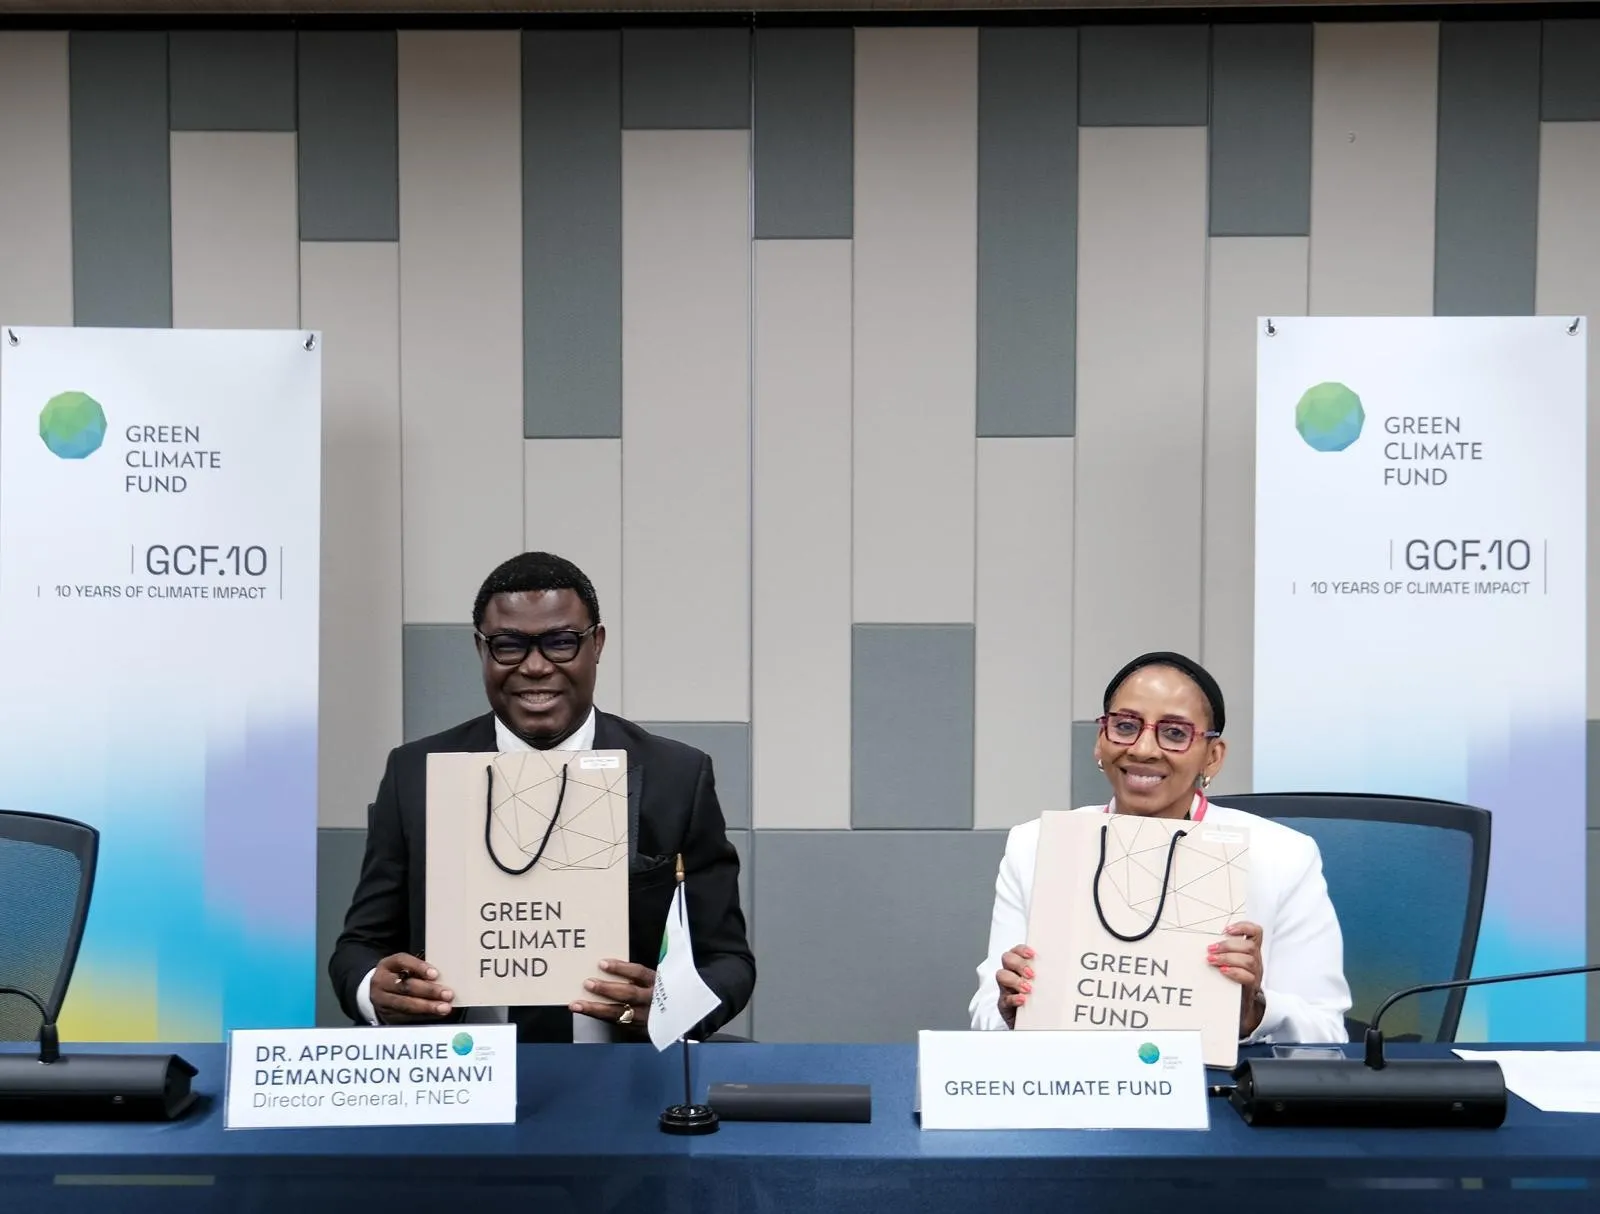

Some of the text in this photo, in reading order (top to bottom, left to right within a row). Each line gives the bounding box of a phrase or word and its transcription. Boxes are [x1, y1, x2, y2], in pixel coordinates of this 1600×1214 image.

[125, 425, 200, 443] GREEN
[1384, 416, 1460, 434] GREEN
[125, 450, 221, 469] CLIMATE
[1384, 442, 1482, 460] CLIMATE
[125, 475, 188, 493] FUND
[1384, 468, 1448, 486] FUND
[146, 544, 267, 577] GCF.10
[1405, 539, 1531, 571] GCF.10
[55, 585, 267, 600] 10 YEARS OF CLIMATE IMPACT
[1310, 582, 1531, 595] 10 YEARS OF CLIMATE IMPACT
[480, 901, 562, 922] GREEN
[480, 928, 586, 950] CLIMATE
[480, 957, 548, 978] FUND
[1080, 951, 1169, 977] GREEN
[1076, 978, 1193, 1008] CLIMATE
[1073, 1004, 1149, 1029] FUND
[256, 1043, 448, 1062] DR. APPOLINAIRE
[255, 1065, 493, 1086] DÉMANGNON GNANVI
[944, 1080, 1172, 1096] GREEN CLIMATE FUND
[253, 1089, 470, 1108] Director General, FNEC
